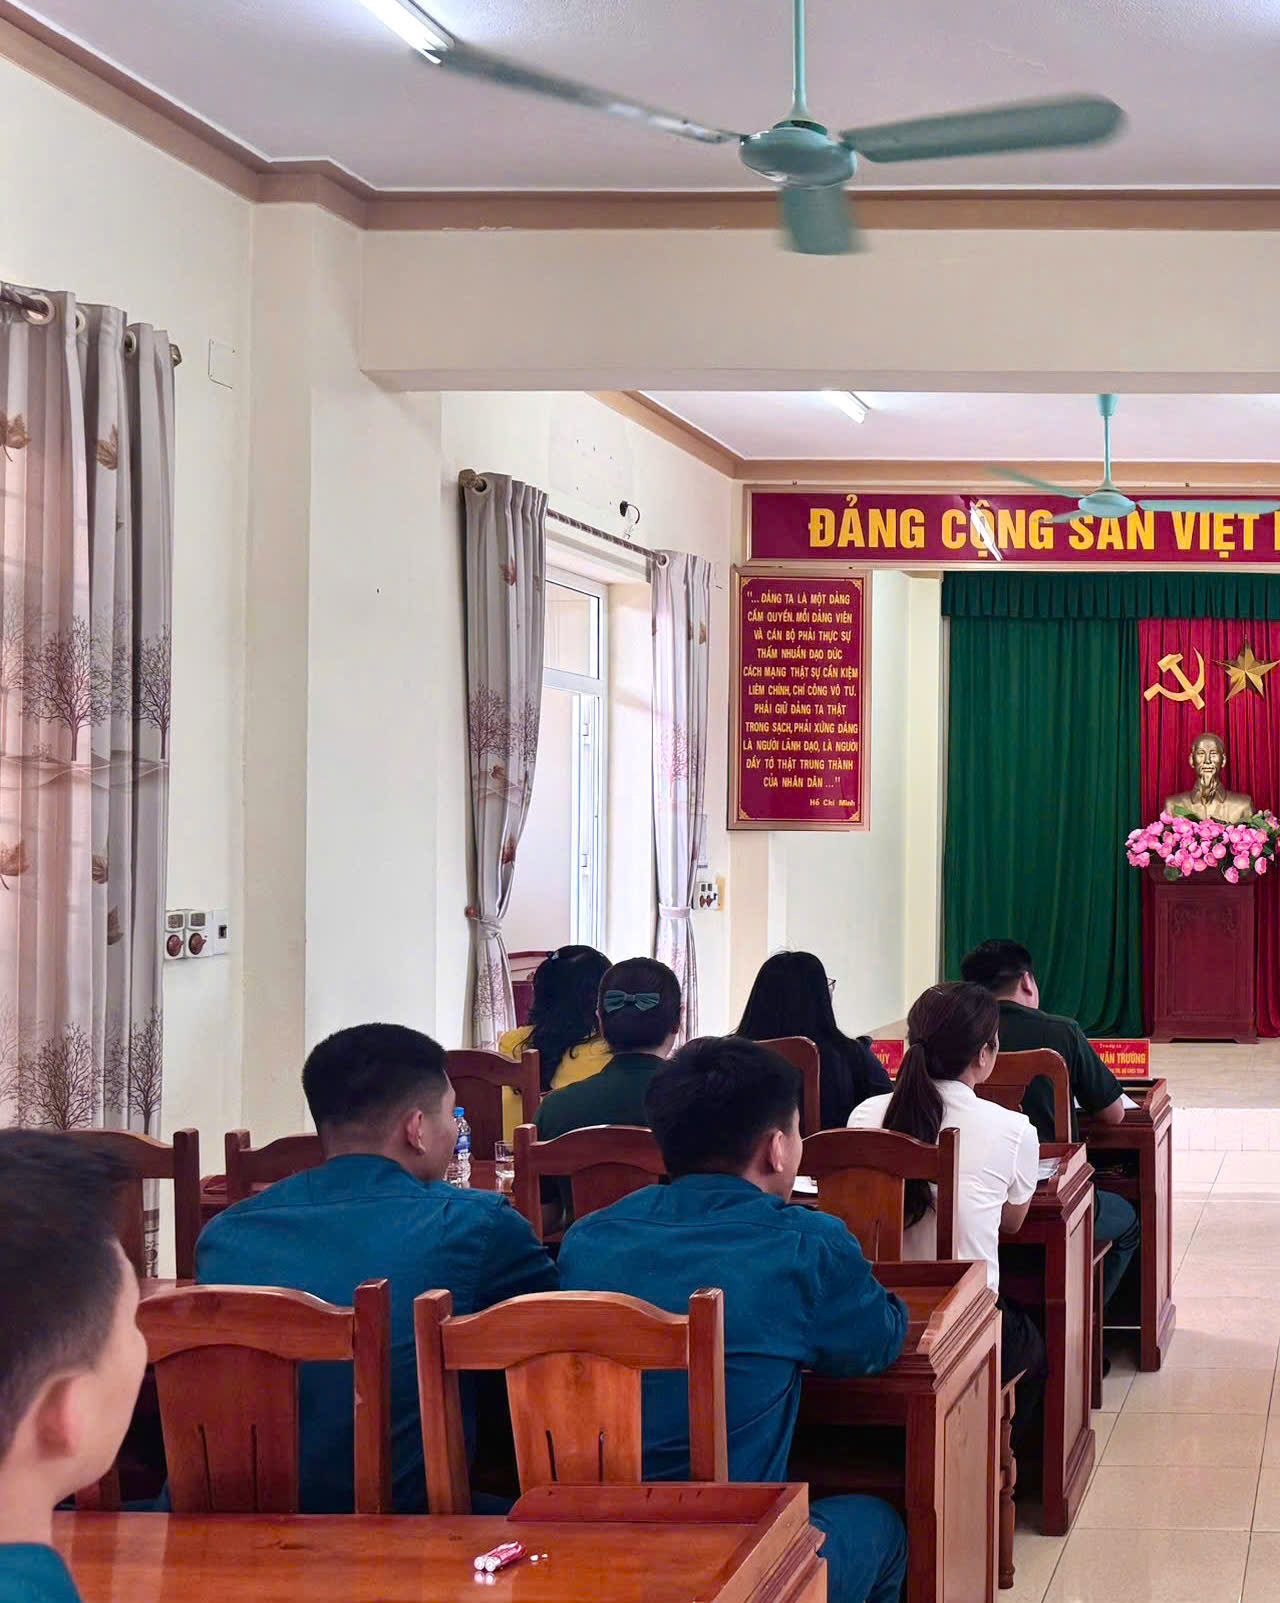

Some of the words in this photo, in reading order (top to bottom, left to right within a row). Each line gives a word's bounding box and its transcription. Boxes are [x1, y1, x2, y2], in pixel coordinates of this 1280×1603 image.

[808, 494, 925, 548] ĐẢNG
[941, 499, 1054, 558] CỘNG
[785, 594, 794, 604] TA
[798, 592, 807, 604] LÀ
[811, 592, 826, 606] MỘT
[836, 611, 852, 623] VIÊN
[754, 627, 763, 640] VÀ
[767, 629, 782, 640] CÁN
[786, 628, 795, 643] BỘ
[798, 627, 815, 640] PHẢI
[819, 630, 838, 643] THỰC
[841, 631, 851, 643] SỰ
[757, 645, 777, 658] THẤM
[744, 665, 762, 676] CÁCH
[764, 667, 786, 679] MẠNG
[791, 665, 809, 679] THẬT
[811, 667, 820, 680] SỰ
[748, 683, 764, 695] LIÊM
[793, 683, 805, 696] CHÍ
[808, 683, 827, 696] CÔNG
[831, 684, 840, 696] VÔ
[754, 700, 772, 713] PHẢI
[775, 701, 787, 714] GIỮ
[815, 705, 824, 714] TA
[827, 703, 846, 717] THẬT
[745, 722, 769, 732] TRONG
[794, 719, 811, 733] PHẢI
[743, 738, 752, 750] LÀ
[757, 738, 779, 750] NGƯỜI
[782, 738, 800, 751] LÃNH
[823, 739, 832, 751] LÀ
[836, 739, 858, 751] NGƯỜI
[765, 756, 774, 769] TỚ
[777, 757, 796, 771] THẬT
[800, 759, 824, 769] TRUNG
[828, 758, 853, 770] THÀNH
[763, 773, 778, 787] CỦA
[782, 775, 803, 787] NHÂN
[807, 776, 823, 788] DÂN
